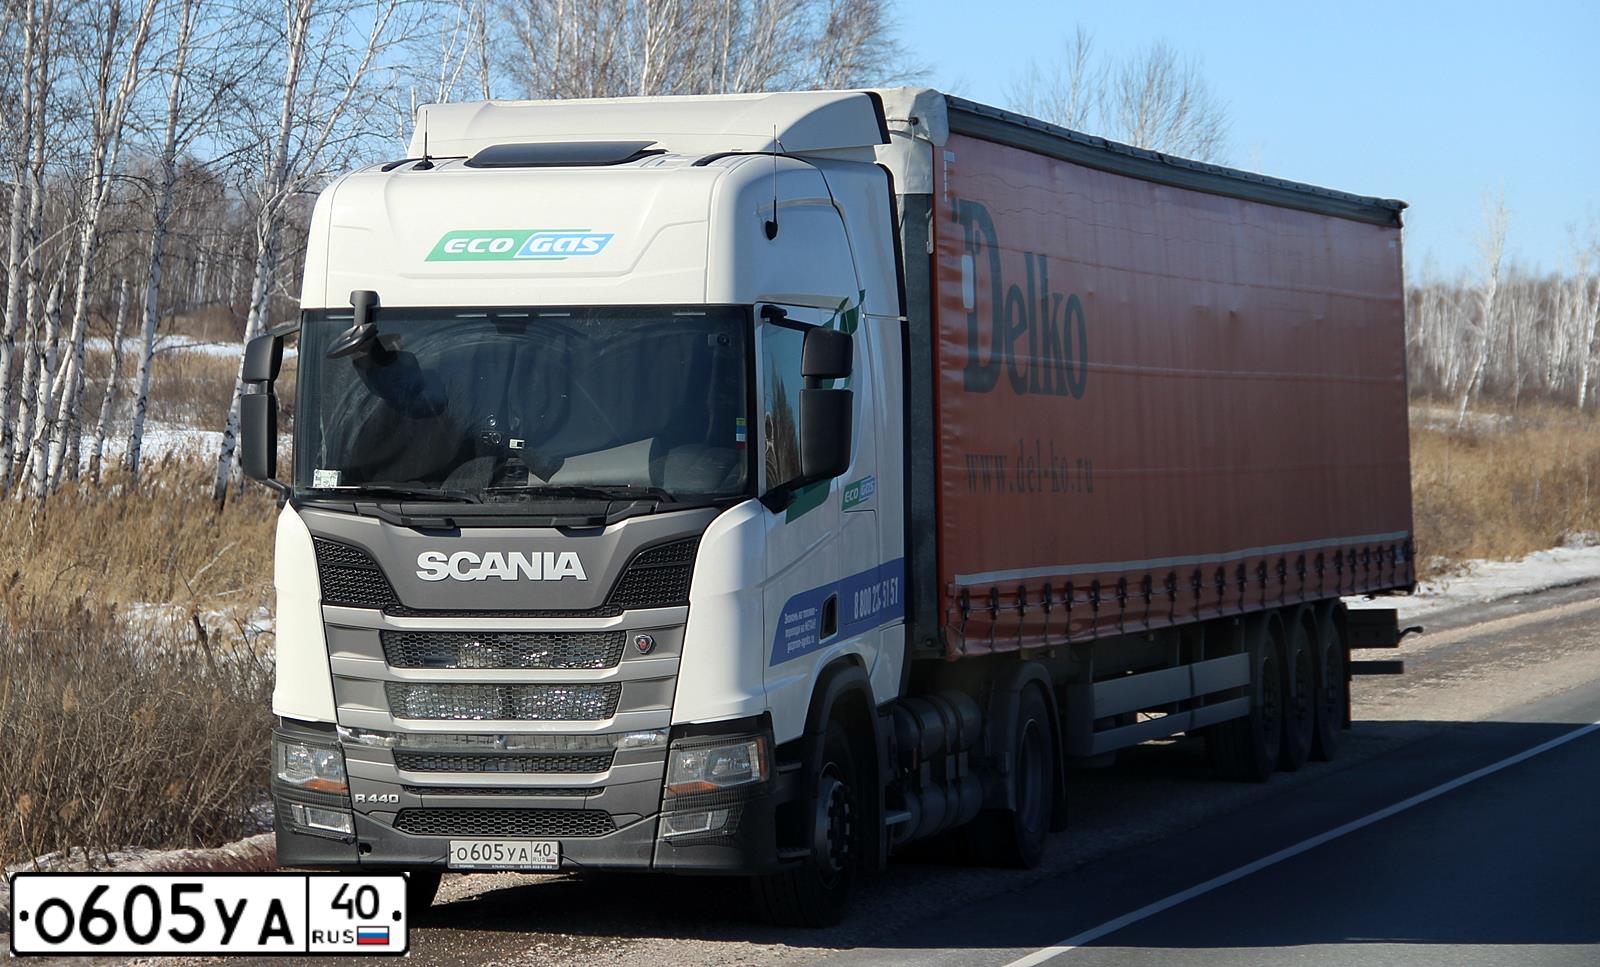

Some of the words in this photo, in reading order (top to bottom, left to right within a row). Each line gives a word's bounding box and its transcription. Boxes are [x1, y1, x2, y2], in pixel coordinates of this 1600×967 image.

[443, 237, 514, 253] ECO
[952, 198, 1087, 400] Delko
[964, 438, 1095, 494] www.del-ko.ru
[415, 551, 587, 581] SCANIA
[533, 843, 552, 857] 40
